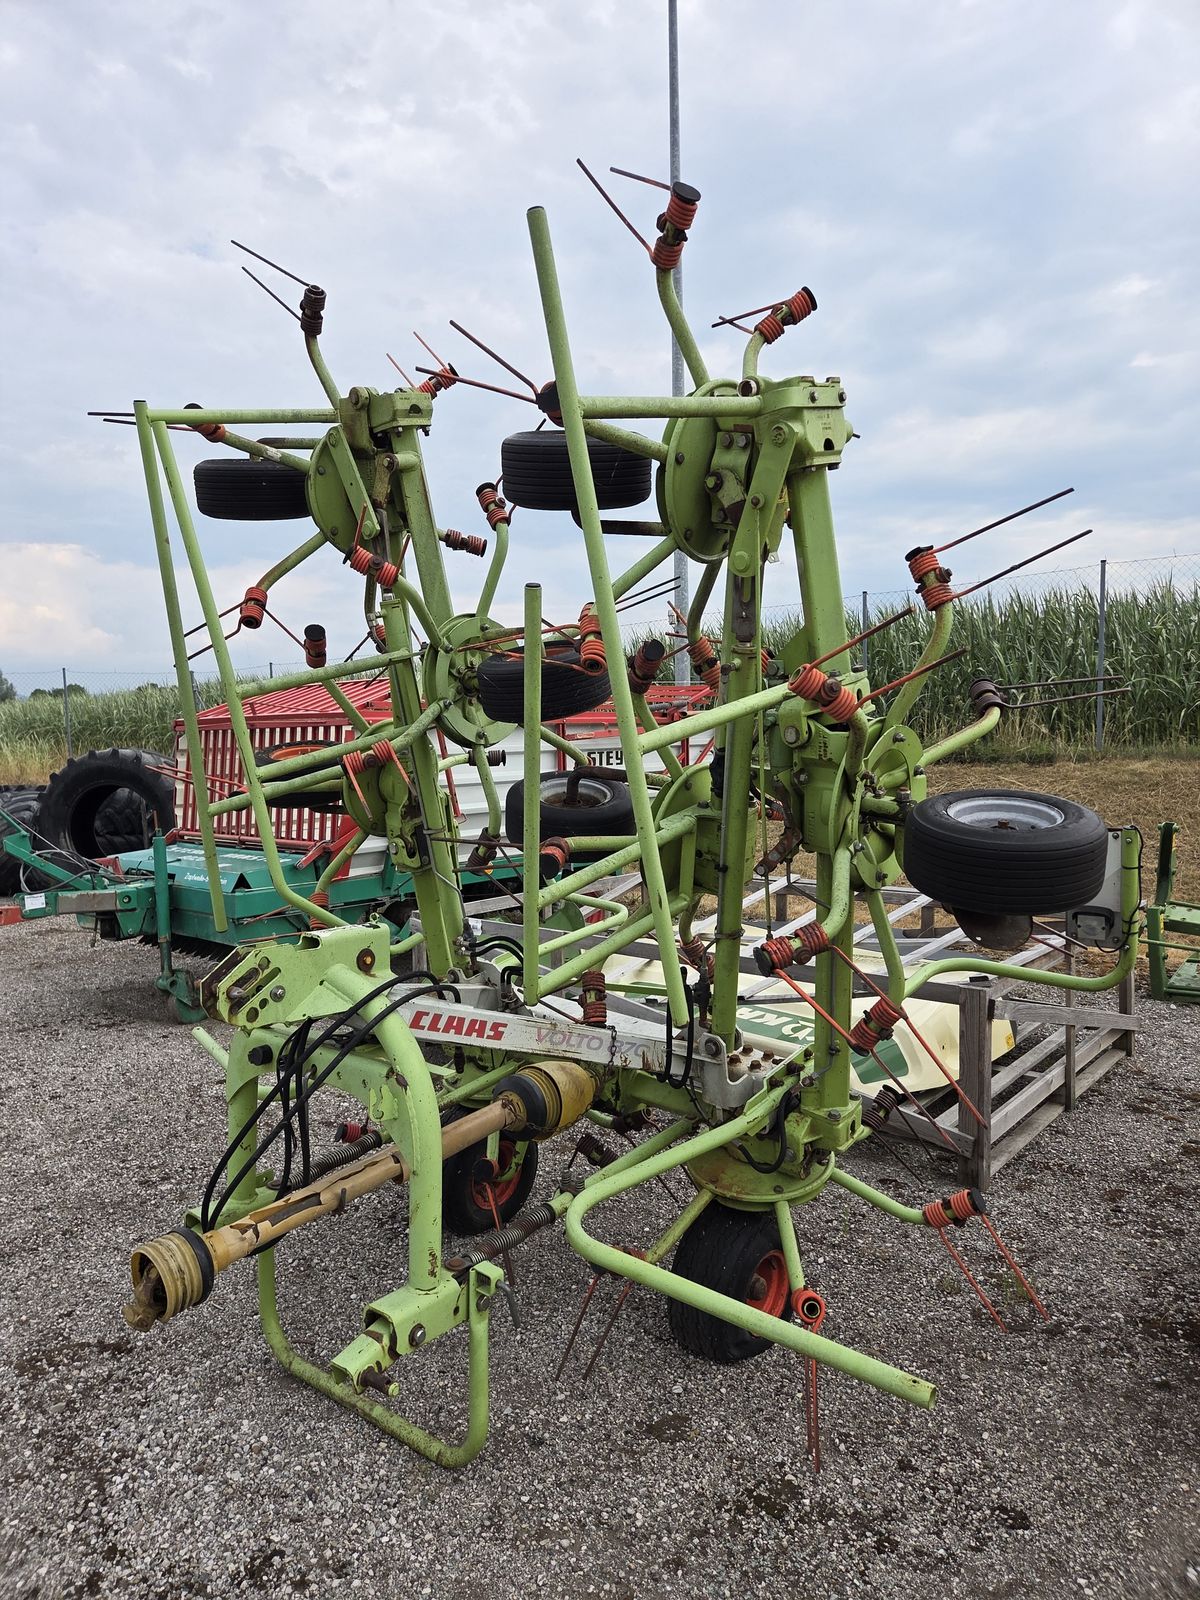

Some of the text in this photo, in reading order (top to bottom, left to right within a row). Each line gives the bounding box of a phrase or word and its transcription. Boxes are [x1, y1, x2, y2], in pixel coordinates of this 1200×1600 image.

[587, 751, 623, 766] STEY
[409, 1011, 508, 1041] CLAAS
[536, 1027, 604, 1050] VOLTO
